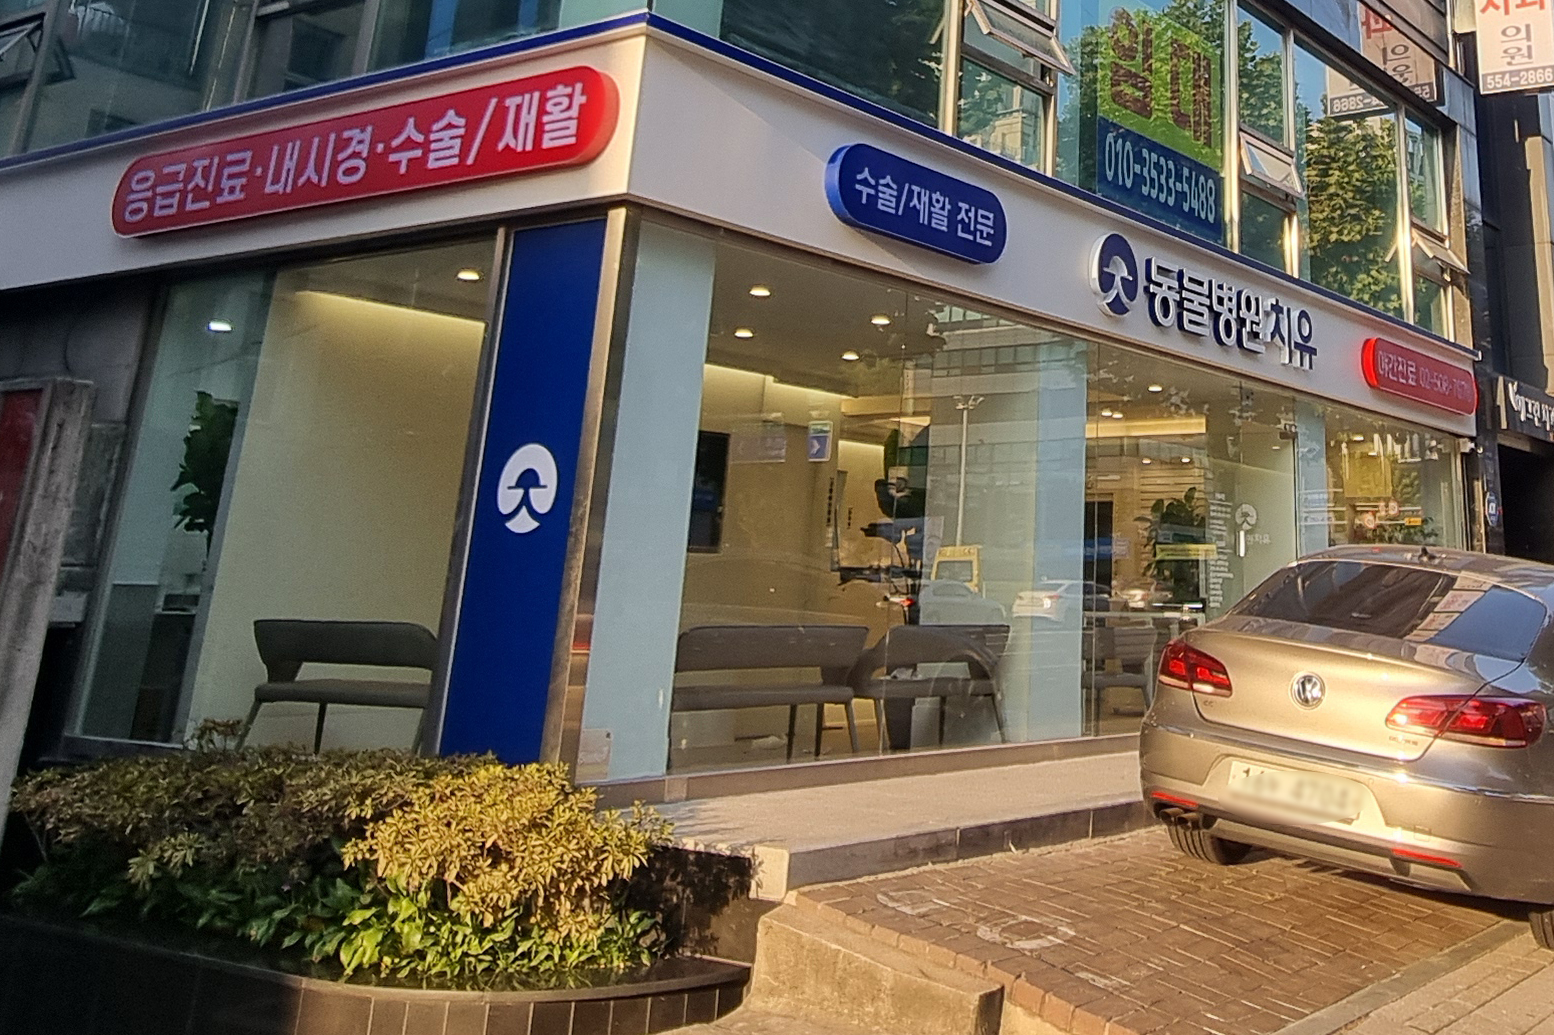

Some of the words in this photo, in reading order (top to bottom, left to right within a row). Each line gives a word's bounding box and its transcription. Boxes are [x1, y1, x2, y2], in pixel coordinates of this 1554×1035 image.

[1500, 24, 1534, 66] 의원
[1109, 7, 1213, 149] 임대
[1486, 67, 1554, 89] 554-2866
[855, 167, 951, 232] 수술/재활
[956, 202, 995, 247] 전문
[1105, 132, 1216, 223] 010-3533-5488
[1378, 351, 1417, 386] 야간진료
